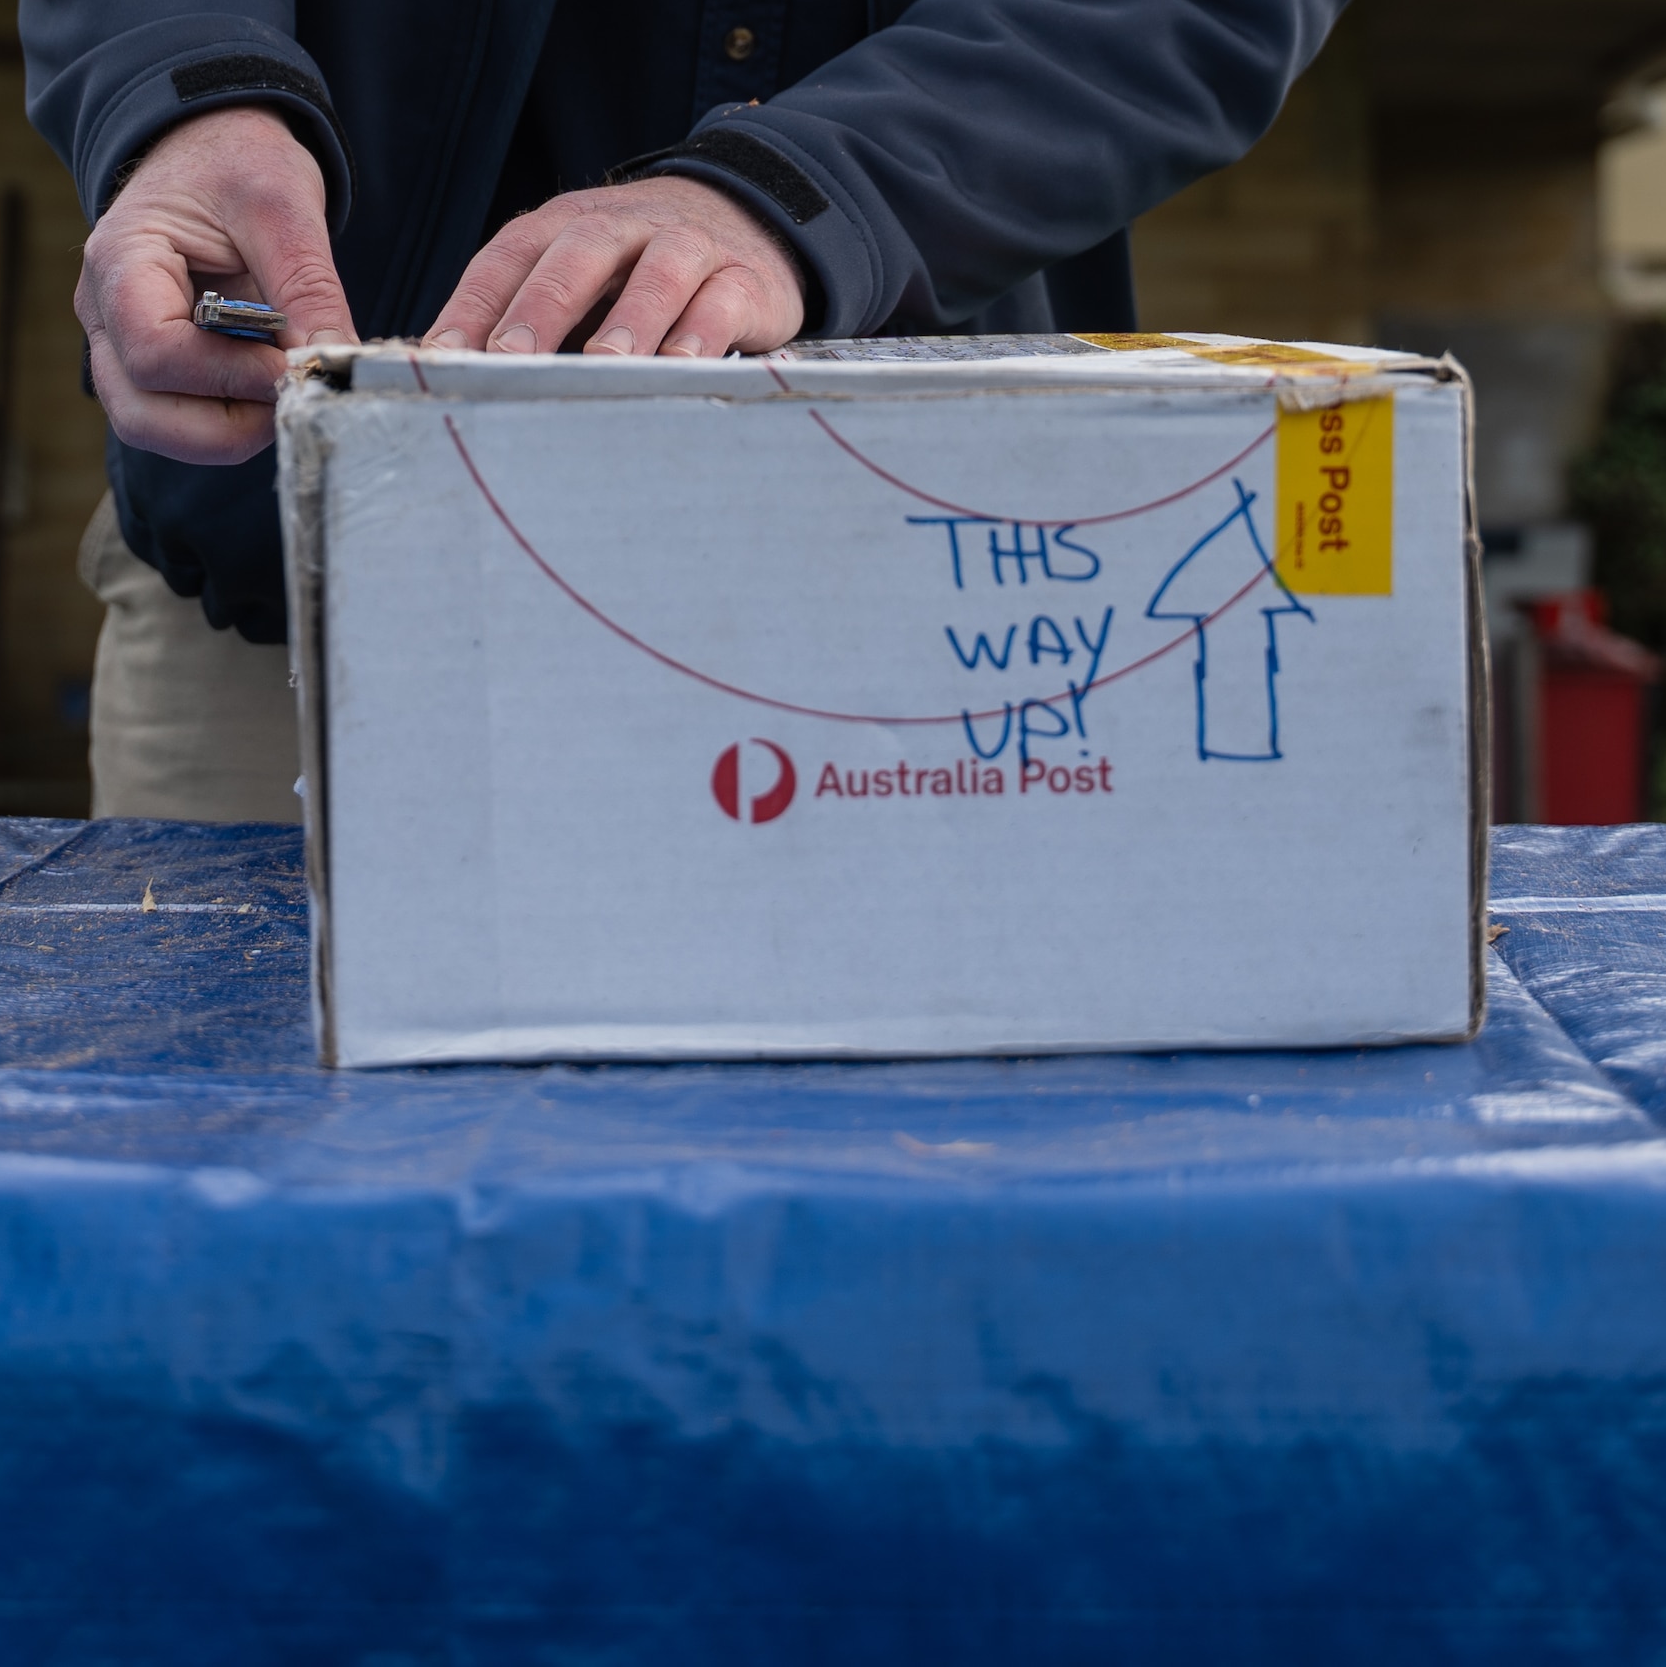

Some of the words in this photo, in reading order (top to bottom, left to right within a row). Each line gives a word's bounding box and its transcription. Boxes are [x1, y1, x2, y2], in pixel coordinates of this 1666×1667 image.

[1318, 465, 1351, 554] Post
[905, 515, 1102, 590] THIS
[945, 604, 1115, 704] WAY
[815, 759, 1005, 798] Australia
[1018, 755, 1114, 795] Post
